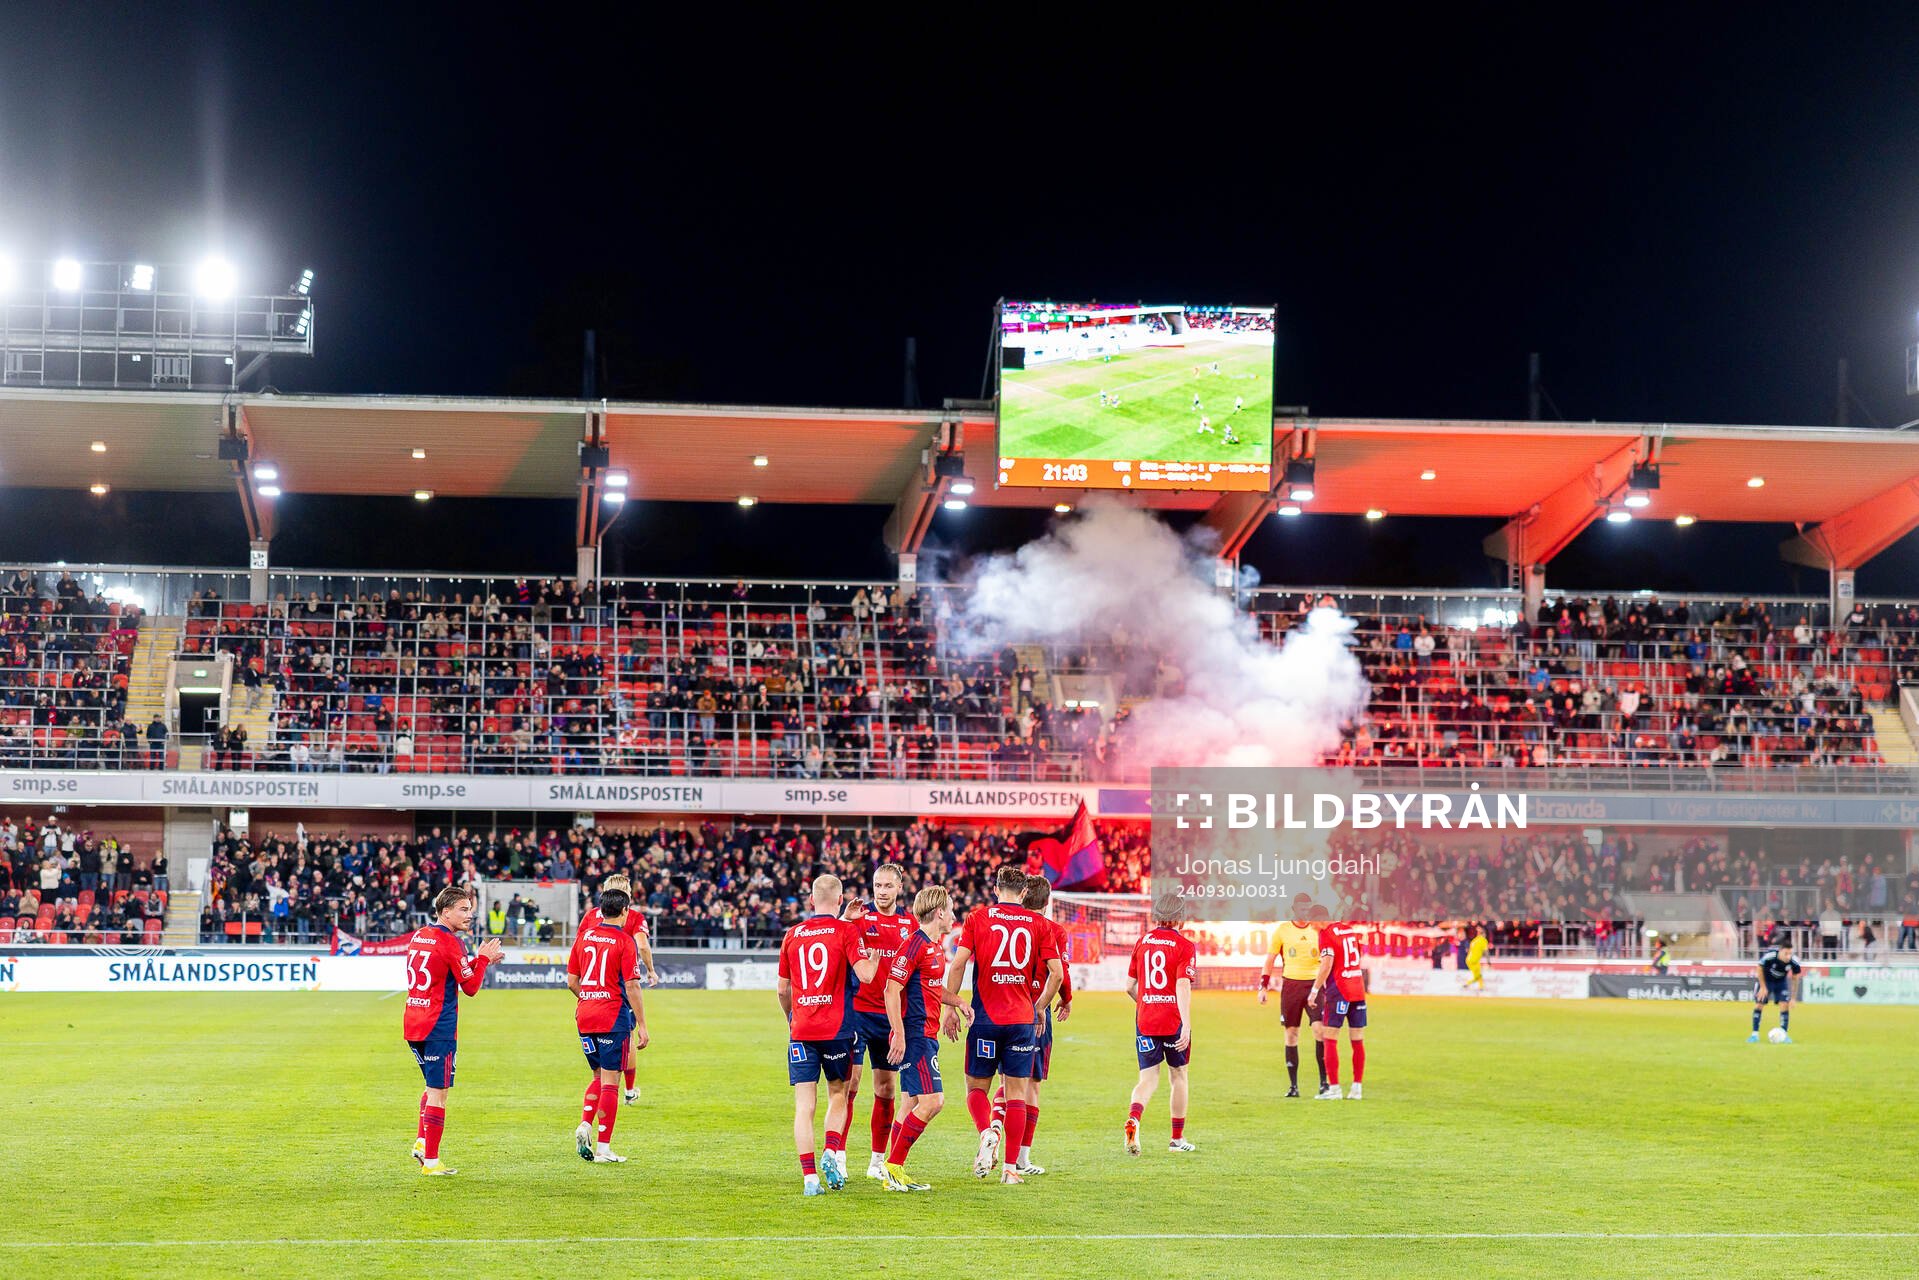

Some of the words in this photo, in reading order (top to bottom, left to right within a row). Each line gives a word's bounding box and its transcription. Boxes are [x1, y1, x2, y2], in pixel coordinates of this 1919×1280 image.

[1042, 463, 1088, 482] 21:03
[12, 776, 78, 795] smp.se
[162, 776, 319, 797] SMÅLANDSPOSTEN
[401, 781, 466, 801] smp.se
[549, 781, 703, 802] SMÅLANDSPOSTEN
[784, 788, 848, 805] smp.se
[928, 787, 1081, 806] SMÅLANDSPOSTEN
[990, 924, 1032, 970] 20
[1342, 936, 1360, 968] 15
[108, 958, 317, 982] SMÅLANDSPOSTEN
[407, 949, 432, 991] 33
[581, 946, 609, 987] 21
[798, 942, 829, 990] 19
[1144, 949, 1168, 990] 18
[495, 970, 545, 983] Rosholm
[658, 971, 697, 984] Juridik
[797, 994, 833, 1007] dynacon
